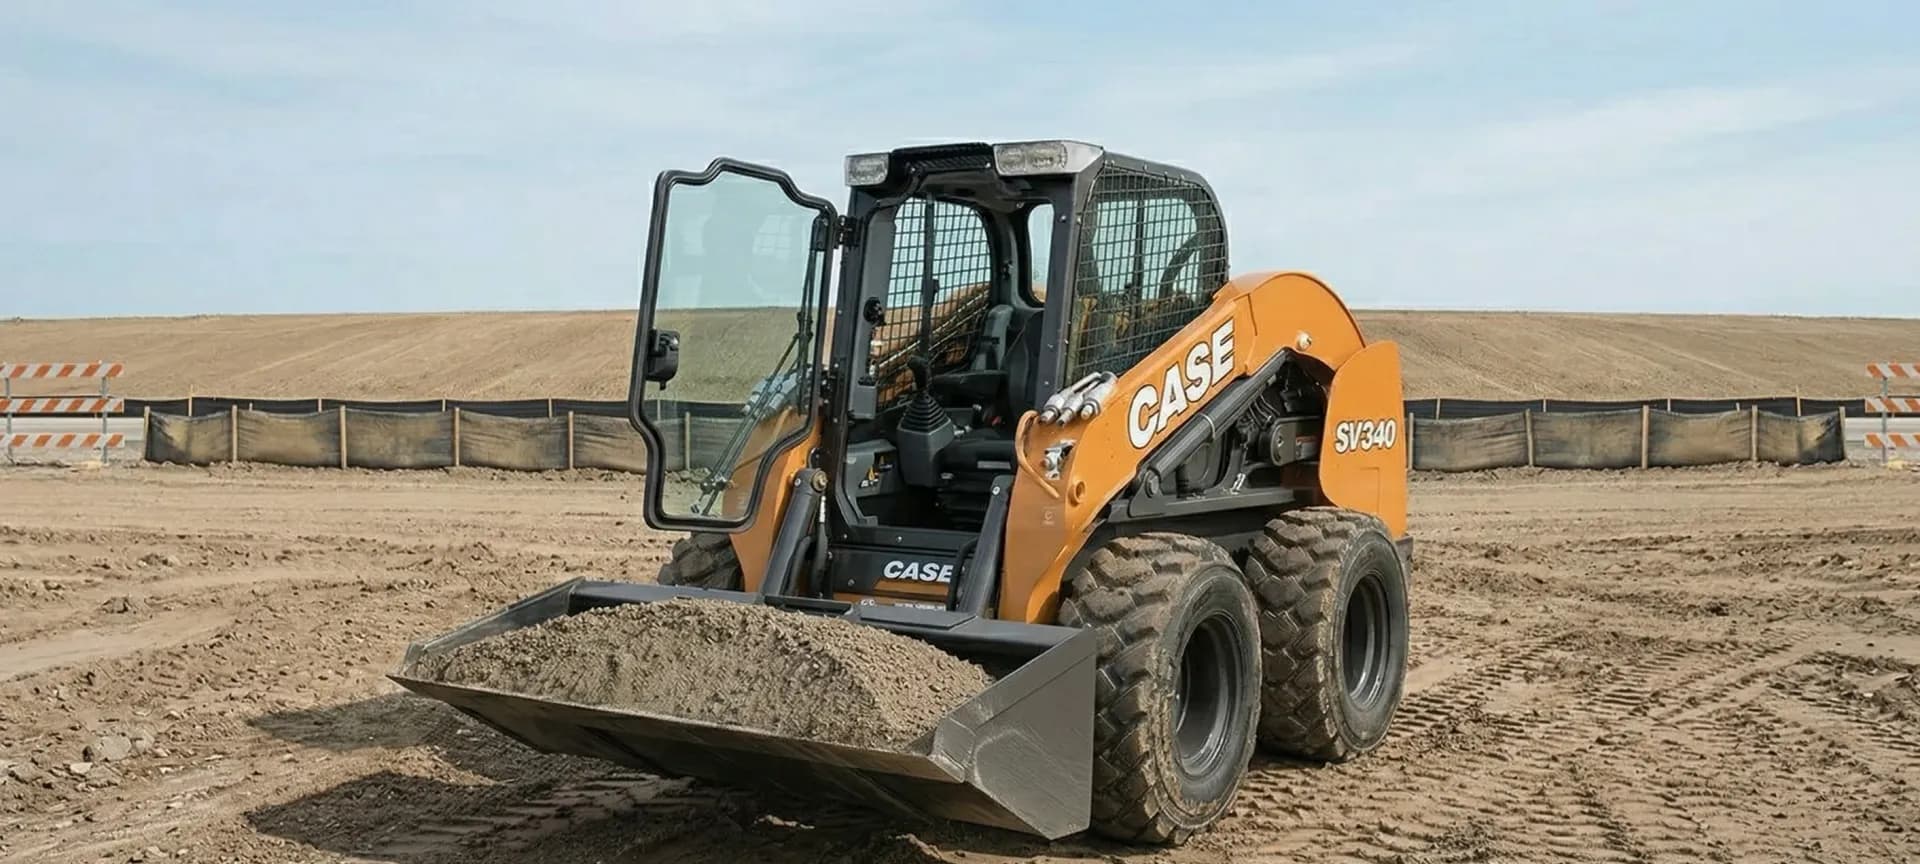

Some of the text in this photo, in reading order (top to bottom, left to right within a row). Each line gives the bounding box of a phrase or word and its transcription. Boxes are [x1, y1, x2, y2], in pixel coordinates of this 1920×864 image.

[1128, 317, 1235, 449] CASE
[1334, 418, 1397, 454] SV340
[883, 560, 953, 583] CASE
